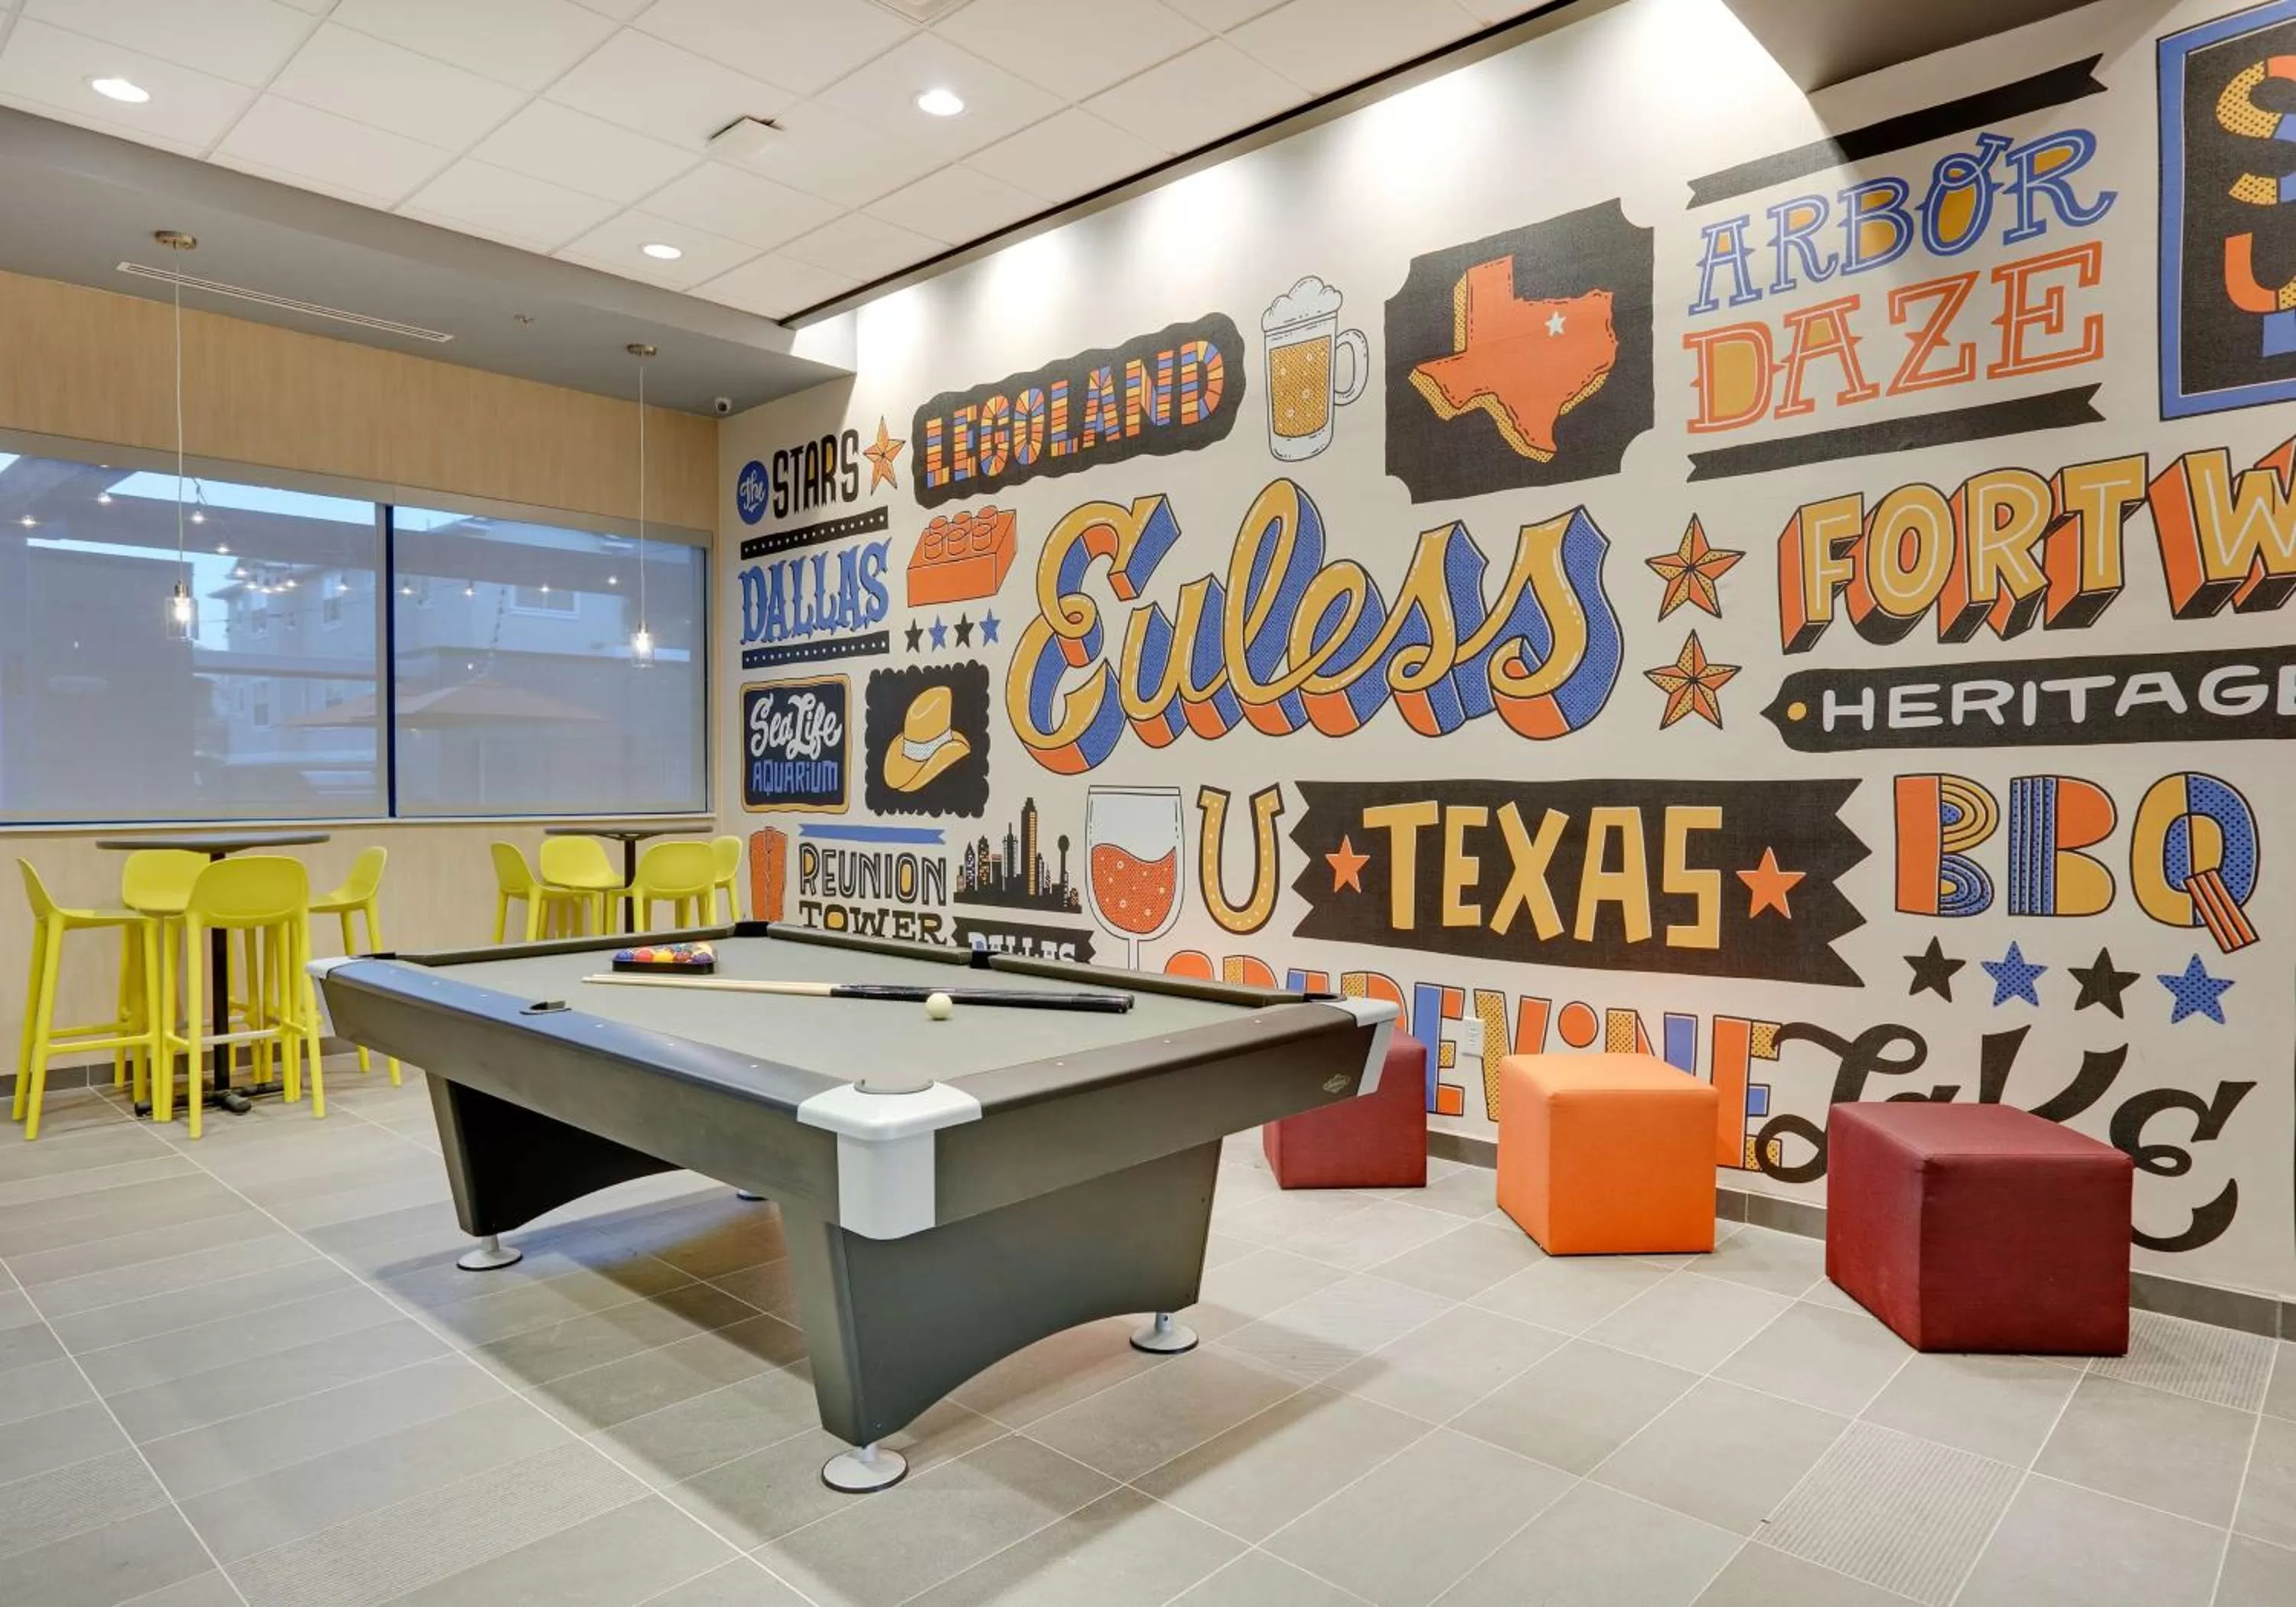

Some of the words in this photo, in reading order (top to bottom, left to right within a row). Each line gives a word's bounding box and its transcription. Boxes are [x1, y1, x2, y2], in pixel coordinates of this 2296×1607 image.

[1688, 128, 2118, 316] ARBOR
[1682, 241, 2105, 435] DAZE
[739, 469, 765, 512] The
[772, 429, 859, 519] STARS
[925, 340, 1225, 490] LEGOLAND
[738, 536, 893, 645] DALLAS
[1005, 477, 1624, 775] Euless
[1778, 451, 2149, 655] FORT
[749, 693, 793, 758] Sea
[787, 692, 843, 760] Life
[799, 842, 947, 906] REUNION
[799, 900, 947, 945] TOWER
[1362, 800, 1724, 949] TEXAS
[1893, 771, 2261, 954] BBQ
